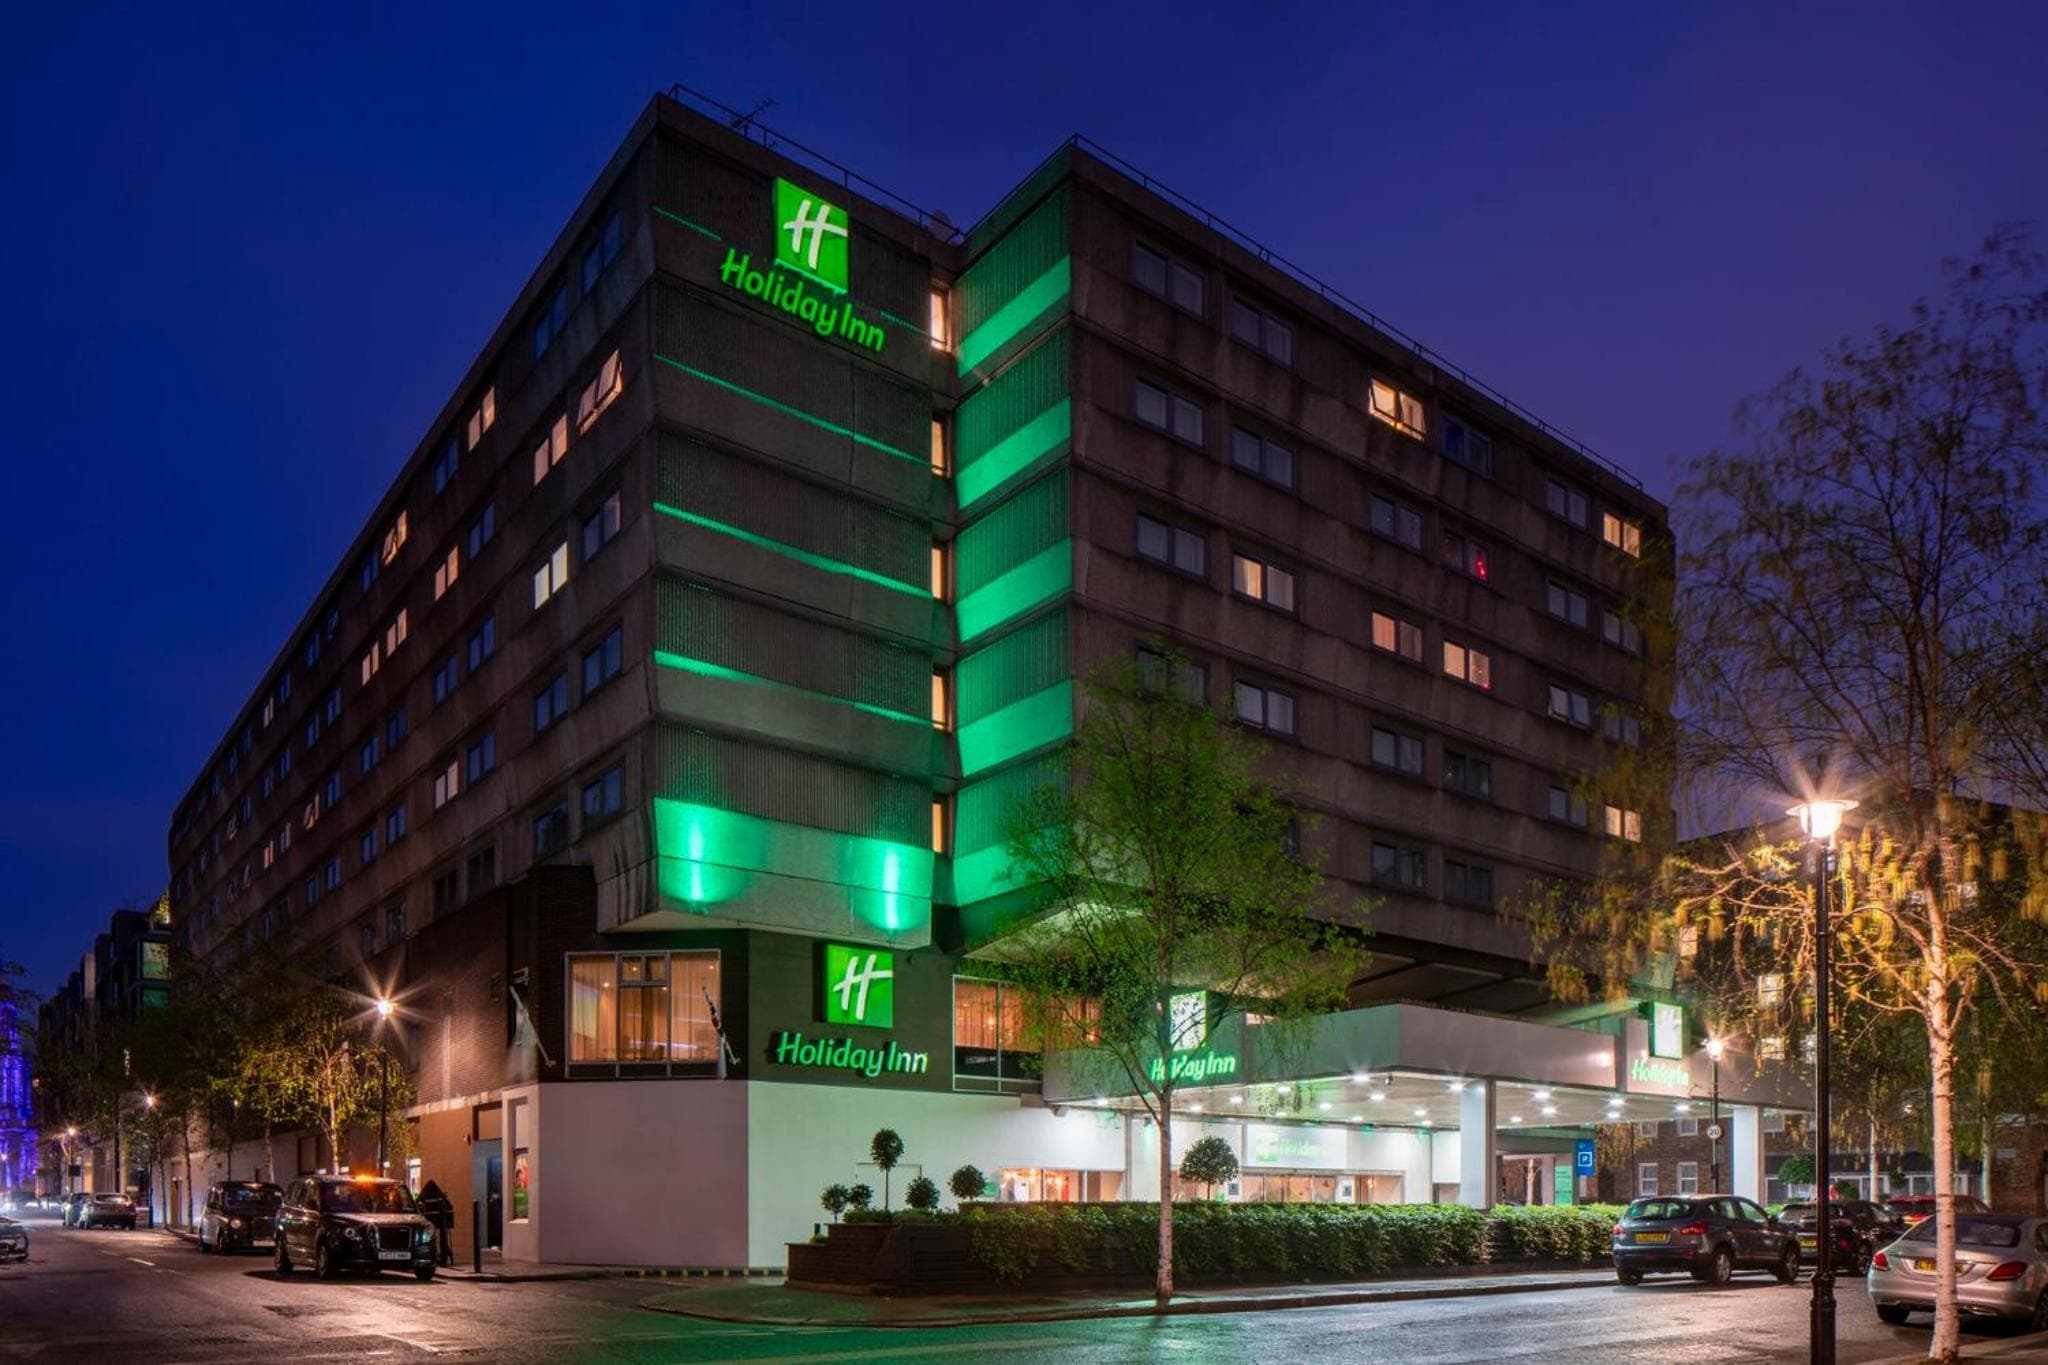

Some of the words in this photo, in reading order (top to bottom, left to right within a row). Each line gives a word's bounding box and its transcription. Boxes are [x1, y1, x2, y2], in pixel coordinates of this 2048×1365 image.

[720, 247, 837, 337] Holiday
[838, 303, 885, 352] Inn
[776, 1031, 885, 1078] Holiday
[886, 1041, 928, 1074] Inn
[1150, 1054, 1207, 1081] Hliay
[1207, 1051, 1235, 1075] Inn
[1709, 1127, 1720, 1136] 20
